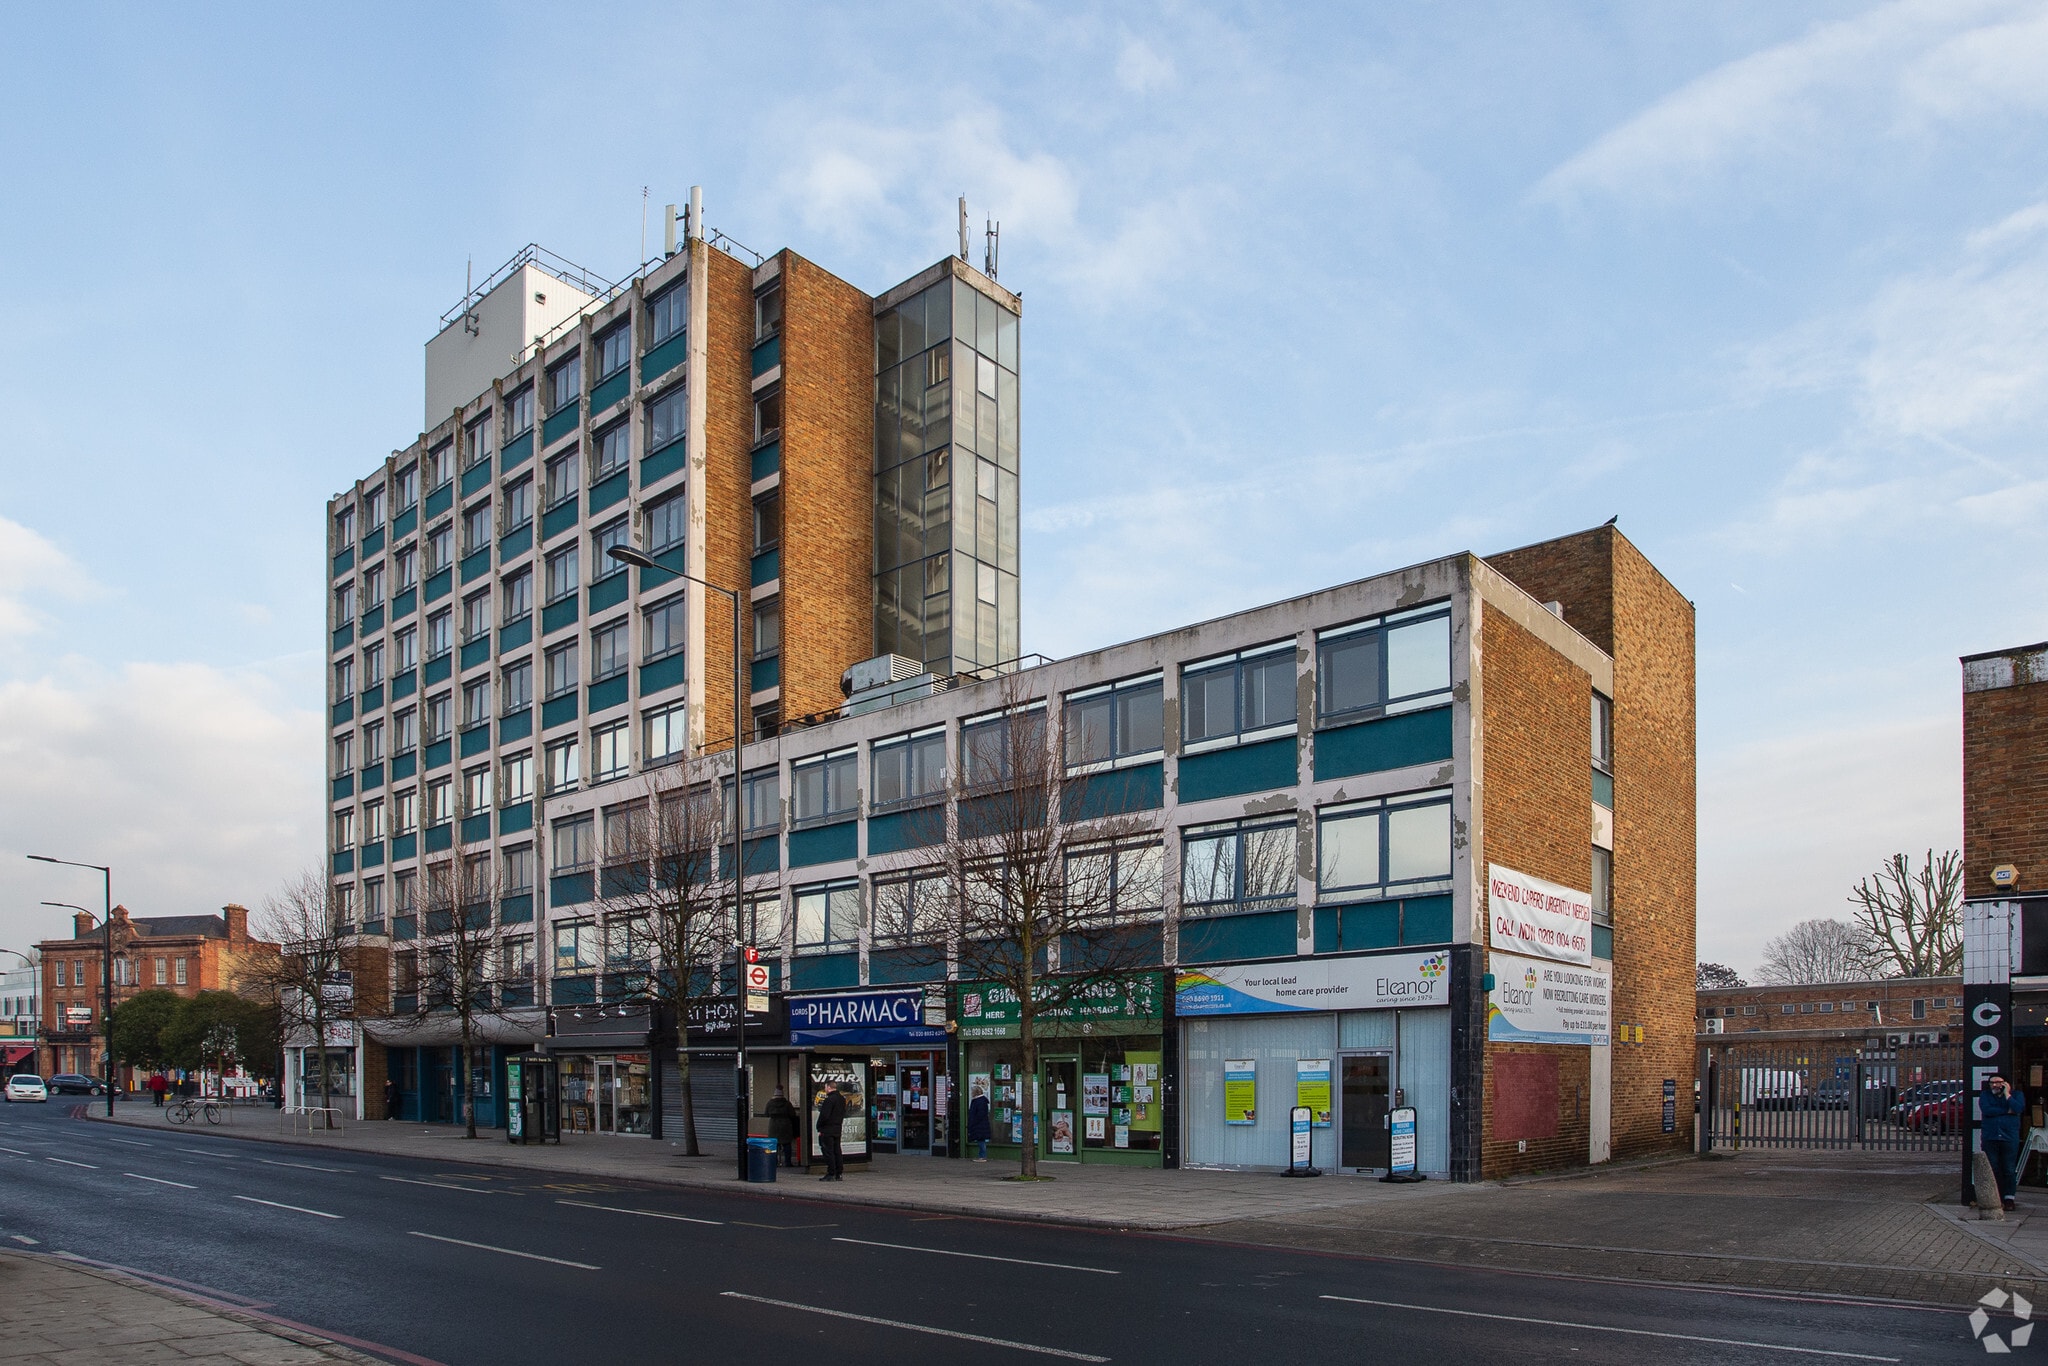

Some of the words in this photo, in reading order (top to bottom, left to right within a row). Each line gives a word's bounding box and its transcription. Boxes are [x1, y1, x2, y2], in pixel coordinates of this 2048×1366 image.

[1491, 878, 1519, 902] WEEKEND
[1522, 888, 1544, 910] CARERS
[1545, 895, 1571, 916] URGENTLY
[1572, 902, 1590, 922] NEEDED
[1496, 916, 1515, 936] CALL
[1518, 921, 1536, 941] NOW
[1538, 927, 1554, 945] 0203
[1556, 932, 1570, 948] 004
[749, 949, 757, 961] F
[1244, 978, 1261, 987] Your
[1262, 977, 1279, 986] local
[1281, 976, 1297, 985] lead
[1376, 977, 1437, 996] Eleanor
[1543, 969, 1553, 982] ARE
[1553, 971, 1563, 983] YOU
[1564, 973, 1583, 986] LOOKING
[1584, 975, 1592, 987] FOR
[1592, 977, 1607, 989] WORK?
[1275, 988, 1296, 997] home
[1298, 987, 1314, 996] care
[1316, 985, 1348, 997] provider
[1503, 981, 1533, 1006] Eleanor
[1543, 988, 1553, 1000] NOW
[1554, 989, 1578, 1003] RECRUITING
[1579, 992, 1589, 1004] CARE
[1589, 993, 1607, 1006] WORKERS
[791, 1007, 808, 1016] LORDS
[807, 997, 923, 1025] PHARMACY
